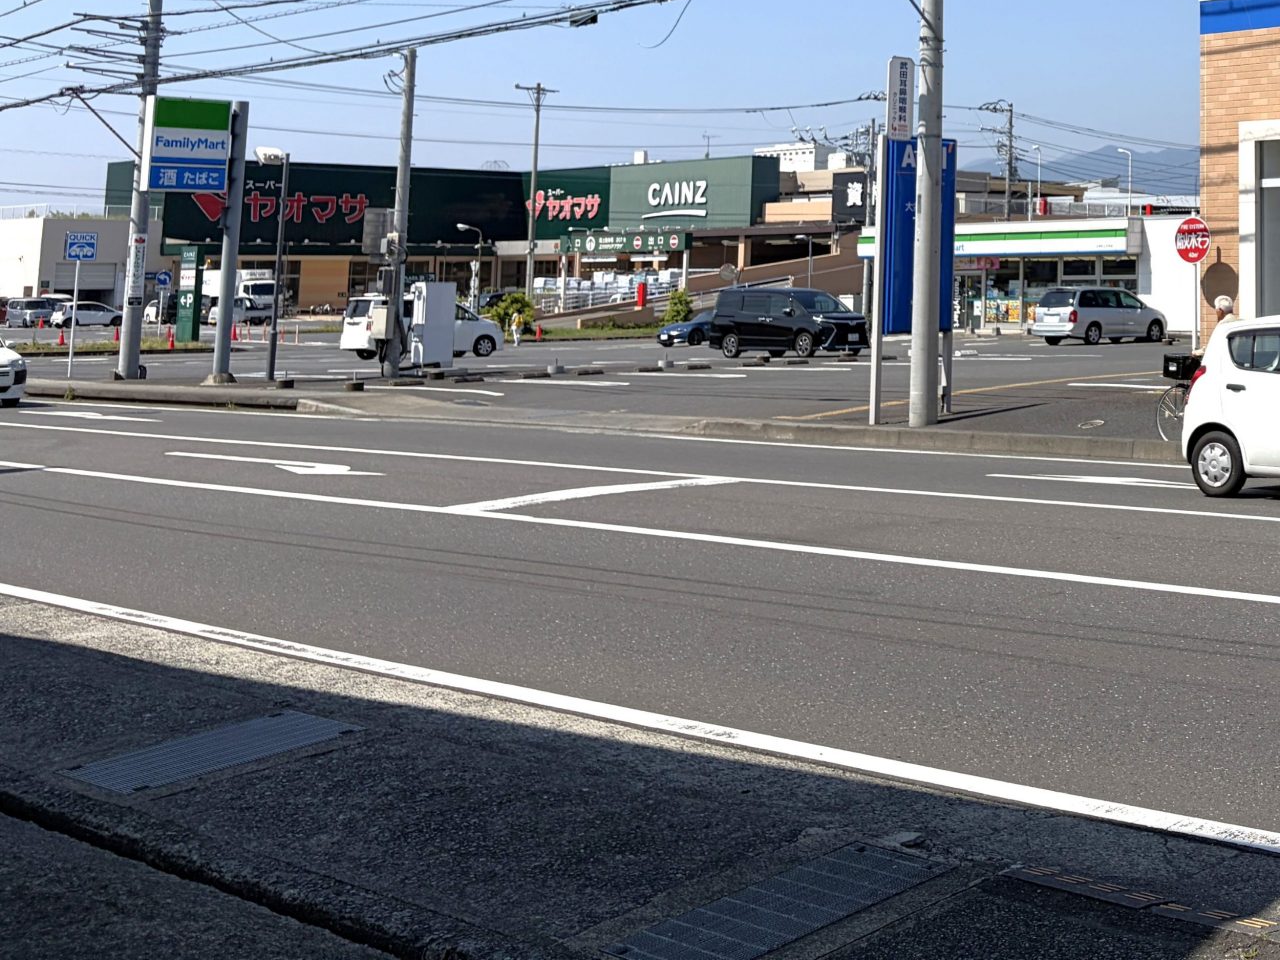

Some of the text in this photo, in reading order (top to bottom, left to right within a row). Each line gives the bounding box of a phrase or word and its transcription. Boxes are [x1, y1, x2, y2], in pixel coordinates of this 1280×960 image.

[155, 136, 226, 151] FamilyMart
[159, 168, 220, 186] 酒 たばこ
[647, 180, 708, 207] CAINZ
[244, 191, 369, 224] ヤオマサ
[546, 194, 601, 221] ヤオマサ
[69, 233, 95, 242] QUICK
[186, 293, 194, 308] P
